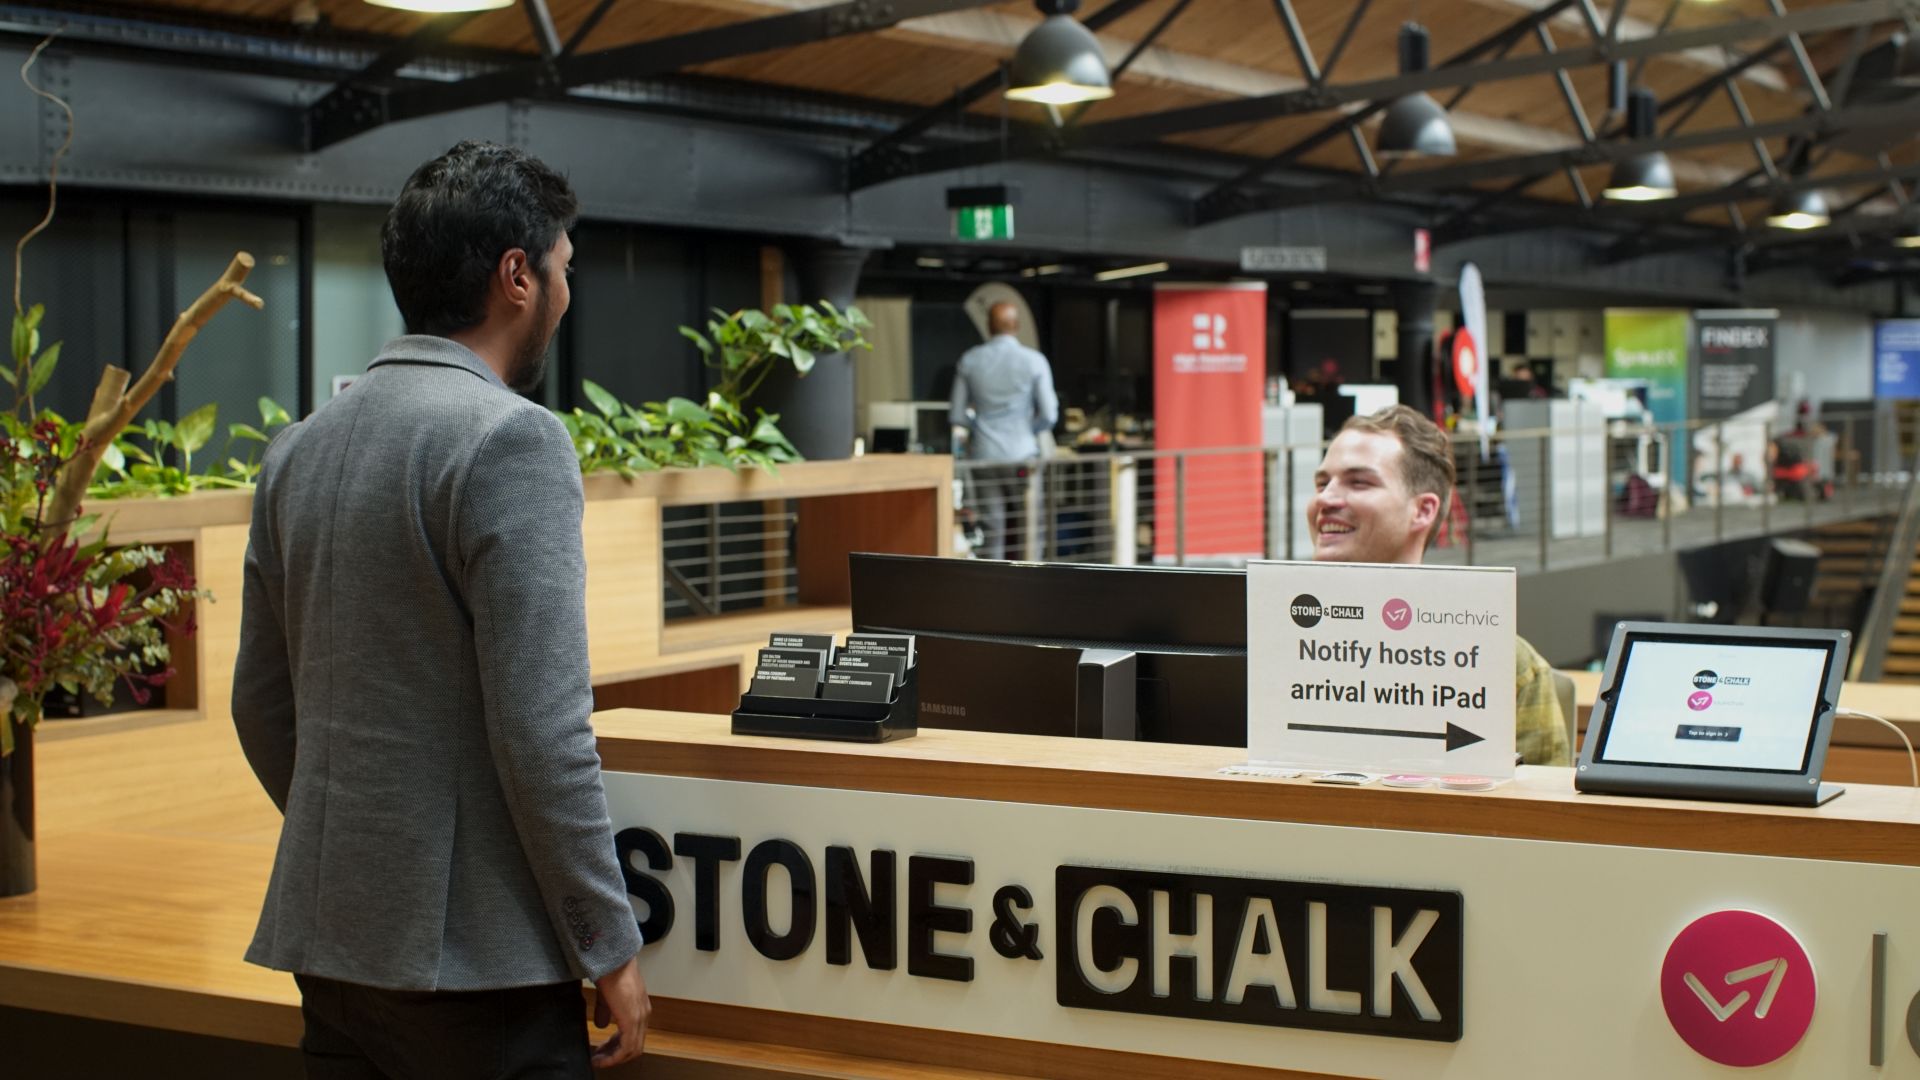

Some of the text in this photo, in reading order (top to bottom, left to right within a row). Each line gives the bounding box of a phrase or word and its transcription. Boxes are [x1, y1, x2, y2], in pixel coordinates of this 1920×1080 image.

[1701, 326, 1769, 348] FINDEX
[1291, 605, 1363, 618] STONE & CHALK
[1417, 608, 1499, 626] launchvic
[1299, 639, 1480, 669] Notify hosts of
[1693, 676, 1717, 684] STONE
[1291, 679, 1486, 709] arrival with iPad
[921, 702, 966, 717] SAMSUNG
[612, 827, 1443, 1022] STONE & CHALK
